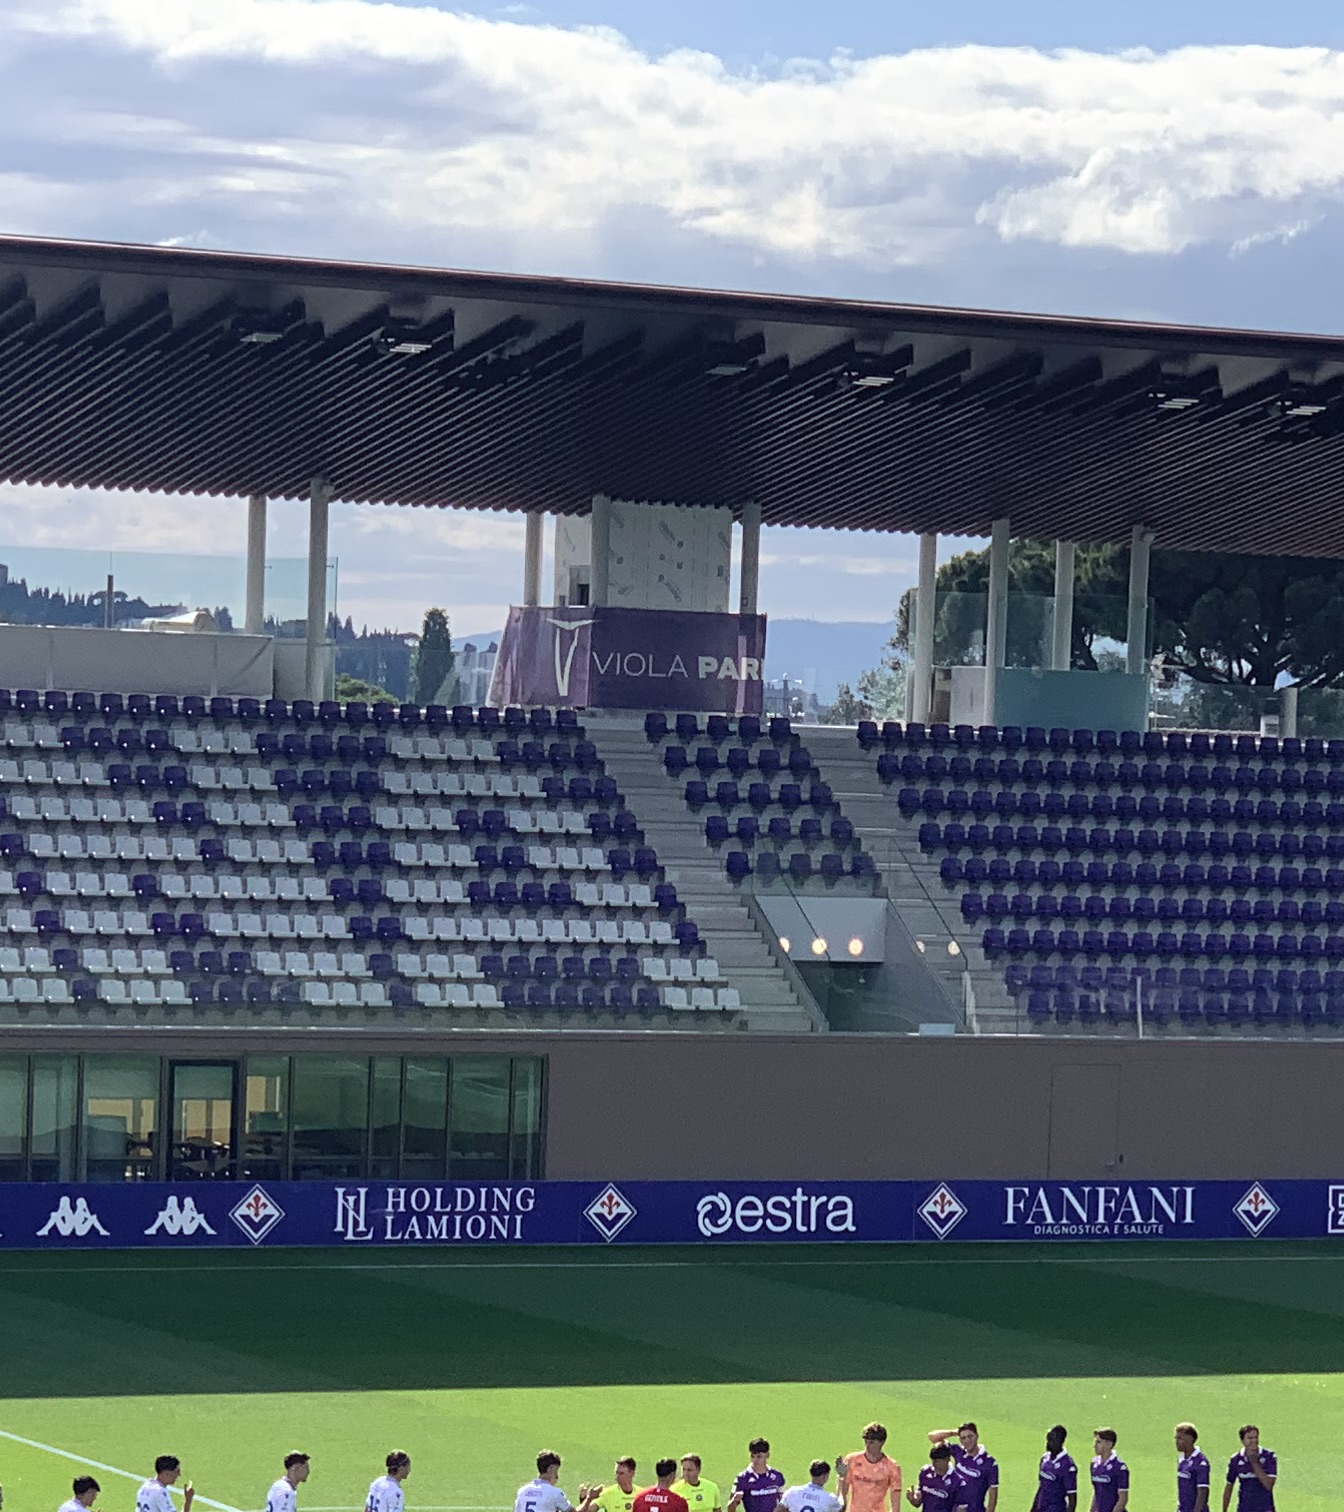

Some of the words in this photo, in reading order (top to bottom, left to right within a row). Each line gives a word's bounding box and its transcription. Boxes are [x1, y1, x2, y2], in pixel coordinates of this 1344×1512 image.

[592, 652, 689, 678] VIOLA
[698, 655, 765, 681] PAR
[385, 1187, 536, 1213] HOLDING
[734, 1187, 857, 1233] estra
[1002, 1186, 1197, 1225] FANFANI
[384, 1214, 524, 1240] LAMIONI
[1033, 1224, 1110, 1236] DIAGNOSTICA
[1113, 1224, 1120, 1235] E
[1123, 1224, 1164, 1235] SALUTE
